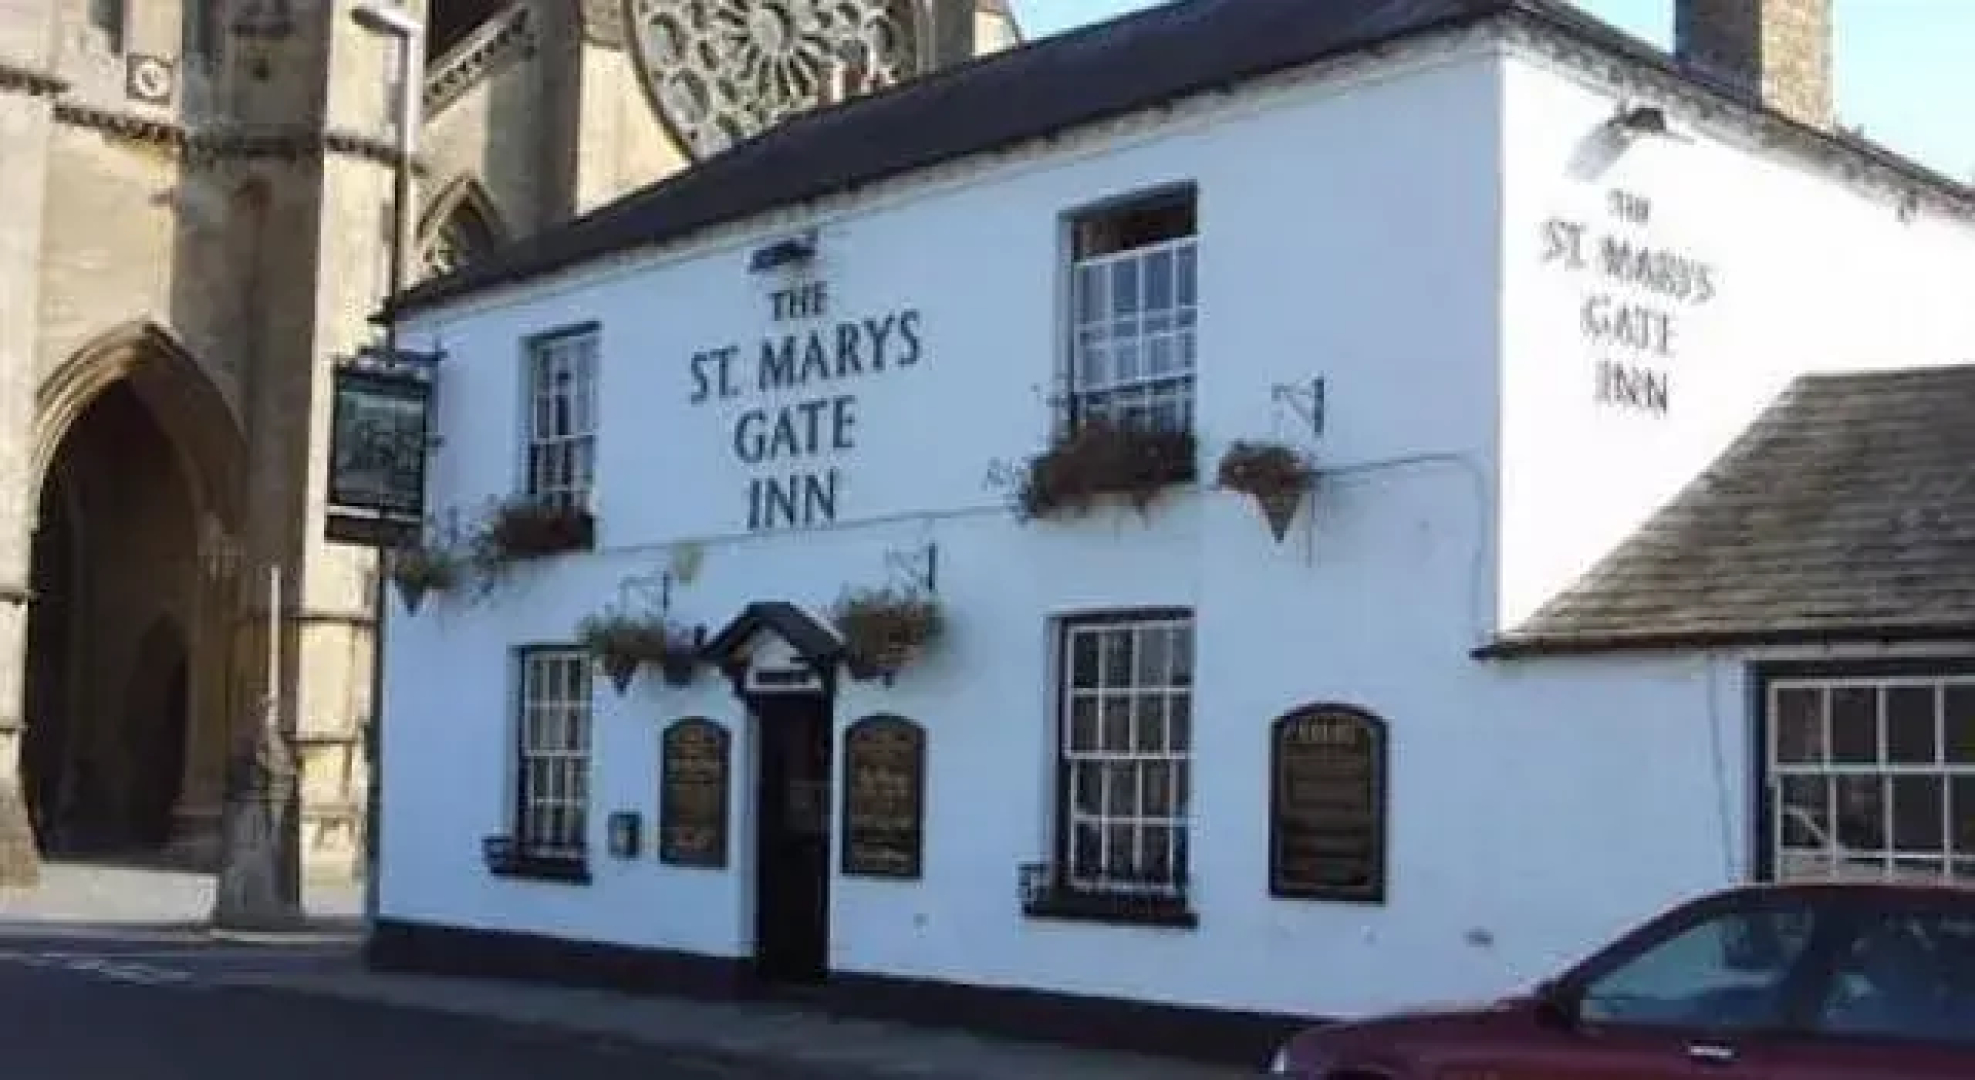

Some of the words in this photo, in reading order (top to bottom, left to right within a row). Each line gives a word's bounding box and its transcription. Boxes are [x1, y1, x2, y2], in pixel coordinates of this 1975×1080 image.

[766, 280, 828, 321] THE
[1579, 296, 1674, 356] GATE
[758, 308, 923, 391] MARYS
[1593, 359, 1668, 415] INN
[734, 394, 857, 464] GATE
[747, 466, 839, 528] INN
